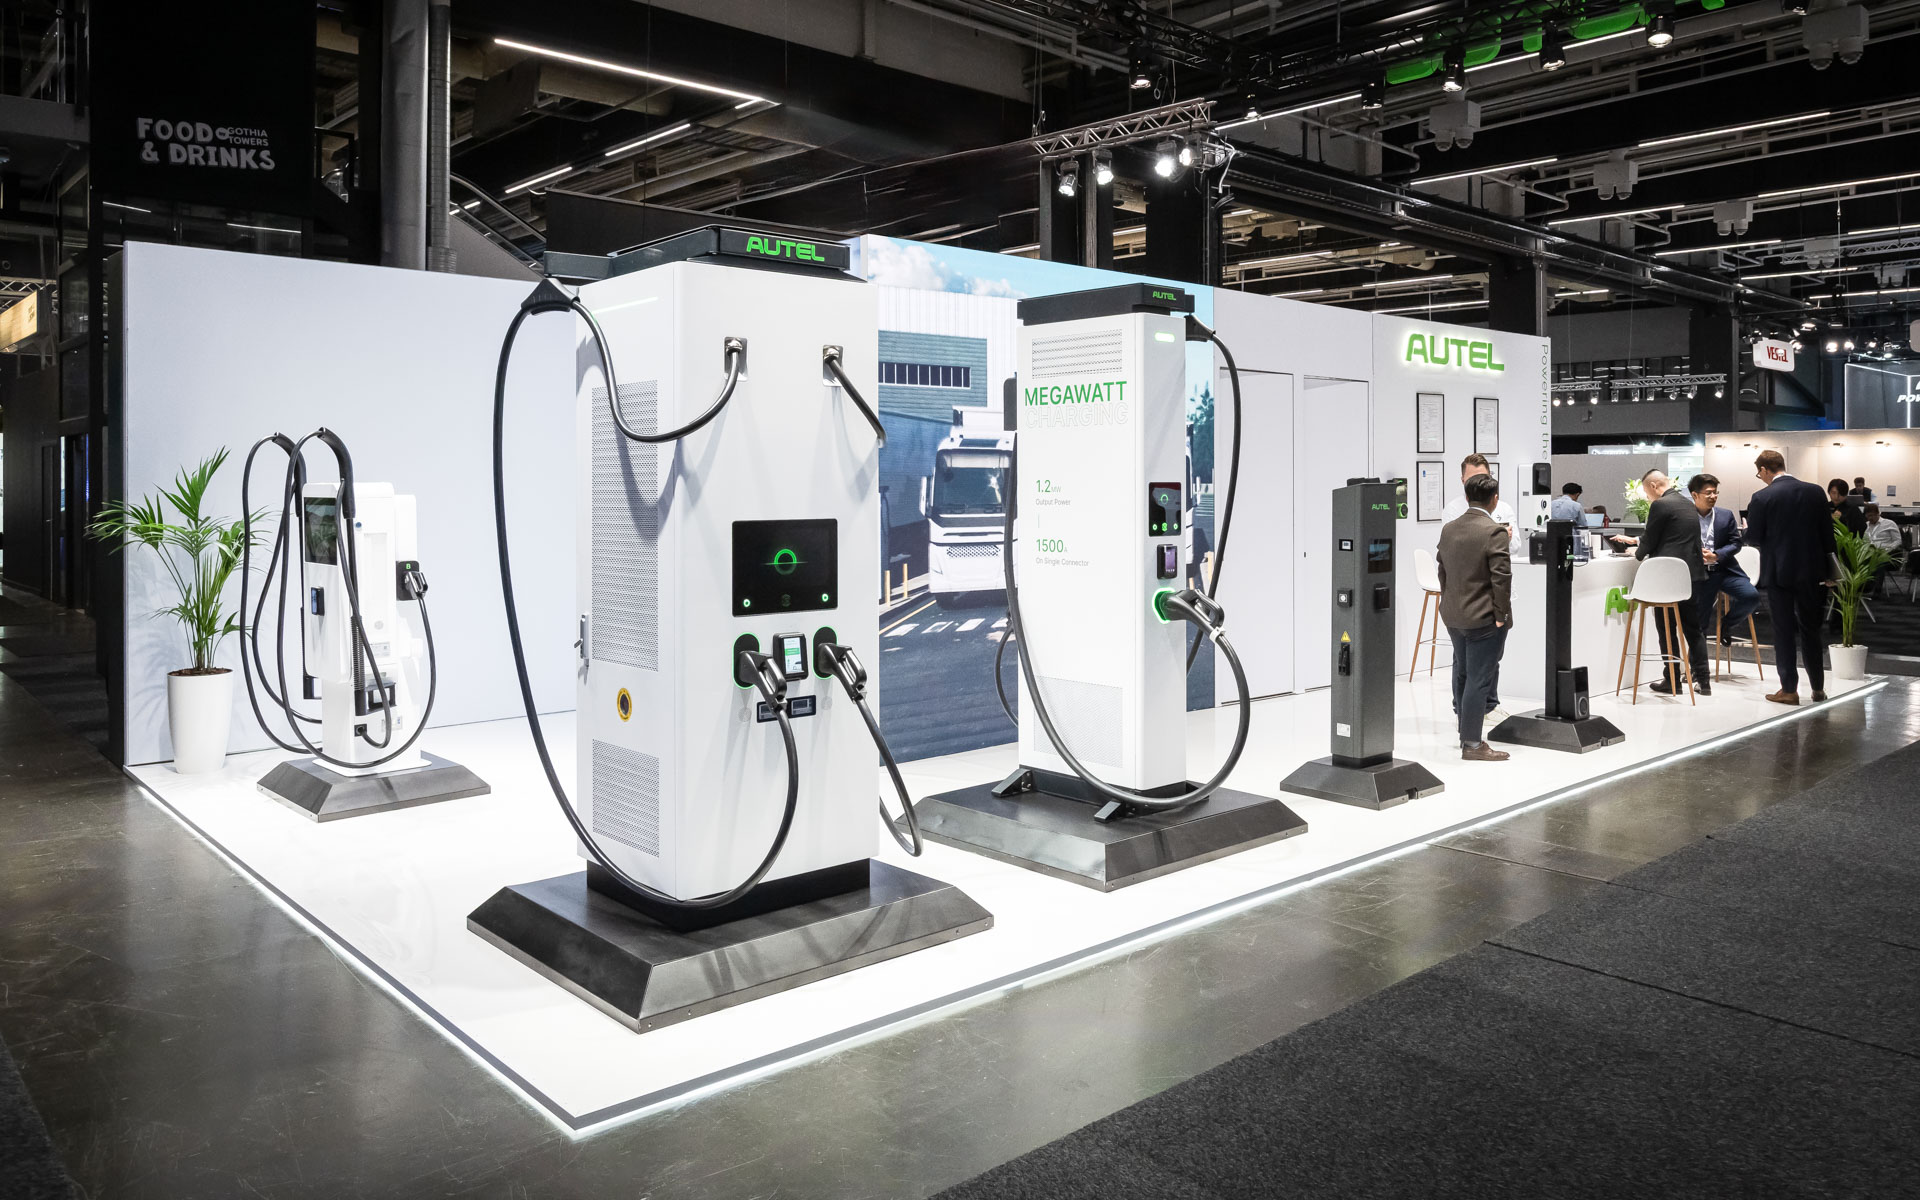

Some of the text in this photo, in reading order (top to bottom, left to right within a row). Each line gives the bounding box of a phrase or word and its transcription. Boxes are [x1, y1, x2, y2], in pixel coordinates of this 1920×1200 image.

[137, 117, 214, 142] FOOD
[227, 126, 268, 137] GOTHIA
[228, 135, 269, 147] TOWERS
[141, 140, 276, 170] & DRINKS
[746, 236, 825, 262] AUTEL
[1152, 290, 1177, 301] AUTEL
[1405, 333, 1505, 371] AUTEL
[1024, 380, 1128, 407] MEGAWATT
[1540, 344, 1549, 425] Powering
[1025, 402, 1129, 429] CHARGING
[1055, 498, 1071, 506] Power
[1371, 503, 1390, 511] AUTEL
